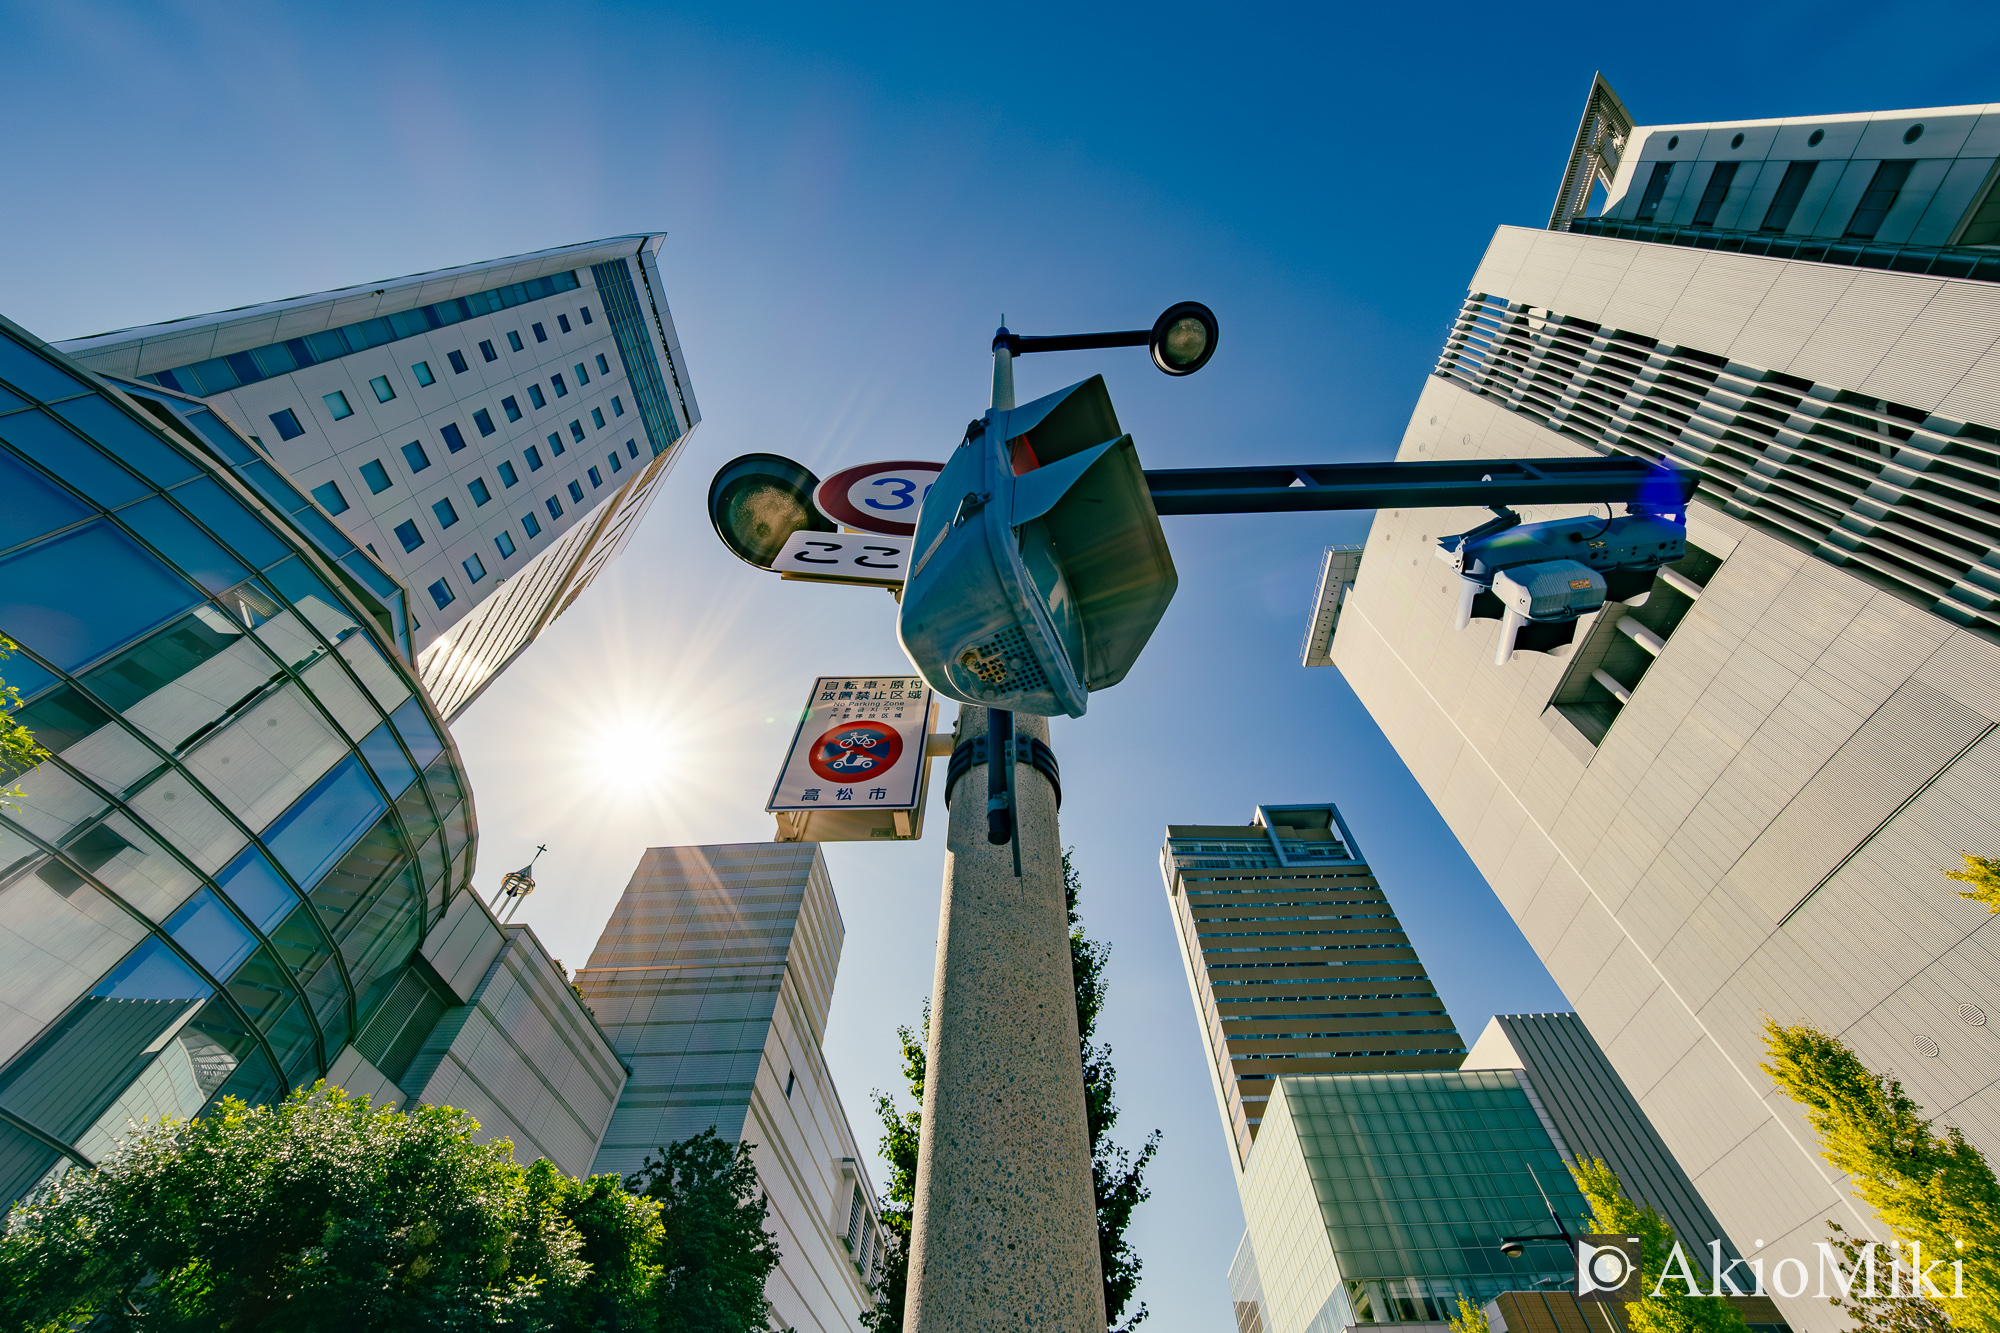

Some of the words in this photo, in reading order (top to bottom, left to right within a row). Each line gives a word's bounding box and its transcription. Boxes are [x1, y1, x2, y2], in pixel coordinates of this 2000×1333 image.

[864, 477, 933, 511] 3
[793, 541, 901, 569] ここ
[819, 690, 922, 701] 放置禁止区域
[800, 787, 888, 802] 高松市
